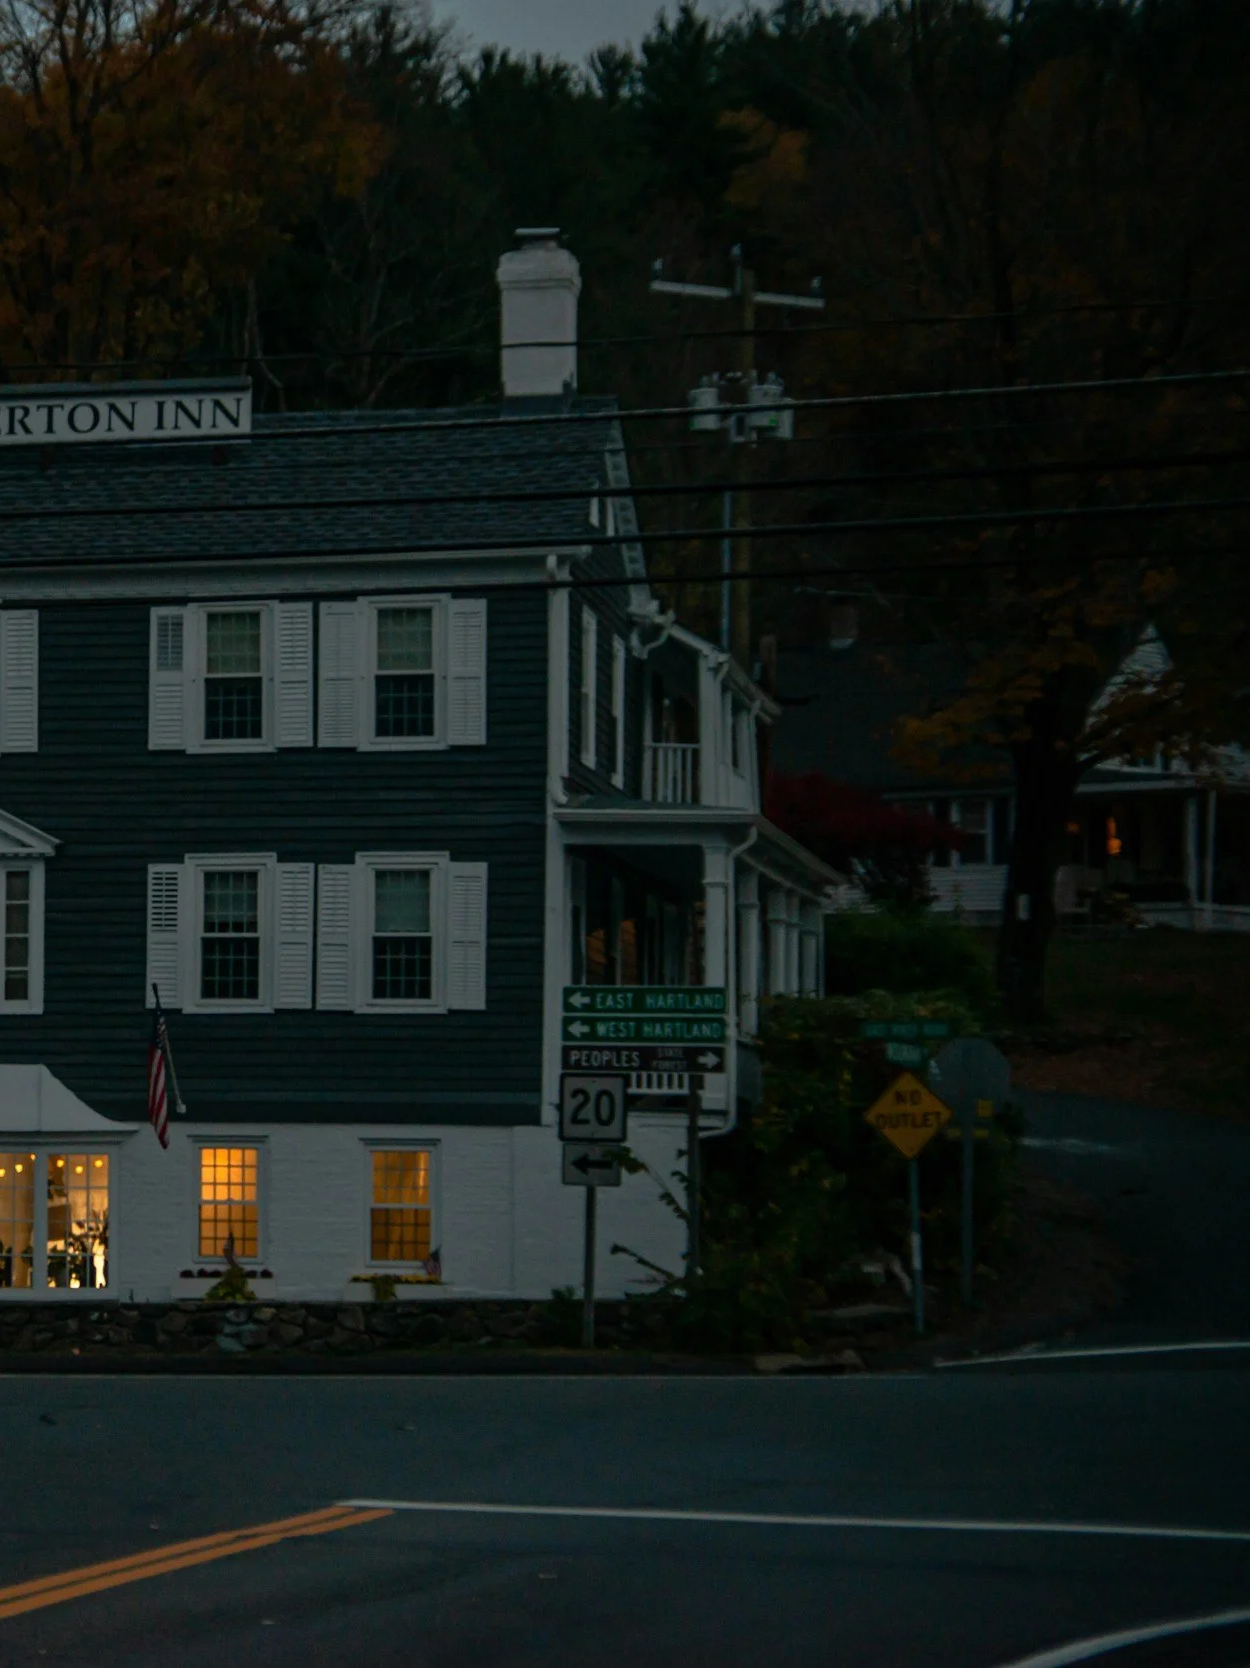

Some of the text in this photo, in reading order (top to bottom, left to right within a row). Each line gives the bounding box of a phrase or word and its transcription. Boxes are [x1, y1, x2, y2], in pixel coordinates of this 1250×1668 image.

[154, 396, 243, 430] INN
[595, 992, 725, 1010] EAST HARTLAND
[595, 1021, 722, 1039] WEST HARTLAND
[568, 1049, 640, 1067] PEOPLES
[893, 1089, 922, 1106] NO
[570, 1088, 615, 1127] 20
[874, 1111, 943, 1130] OUTLET
